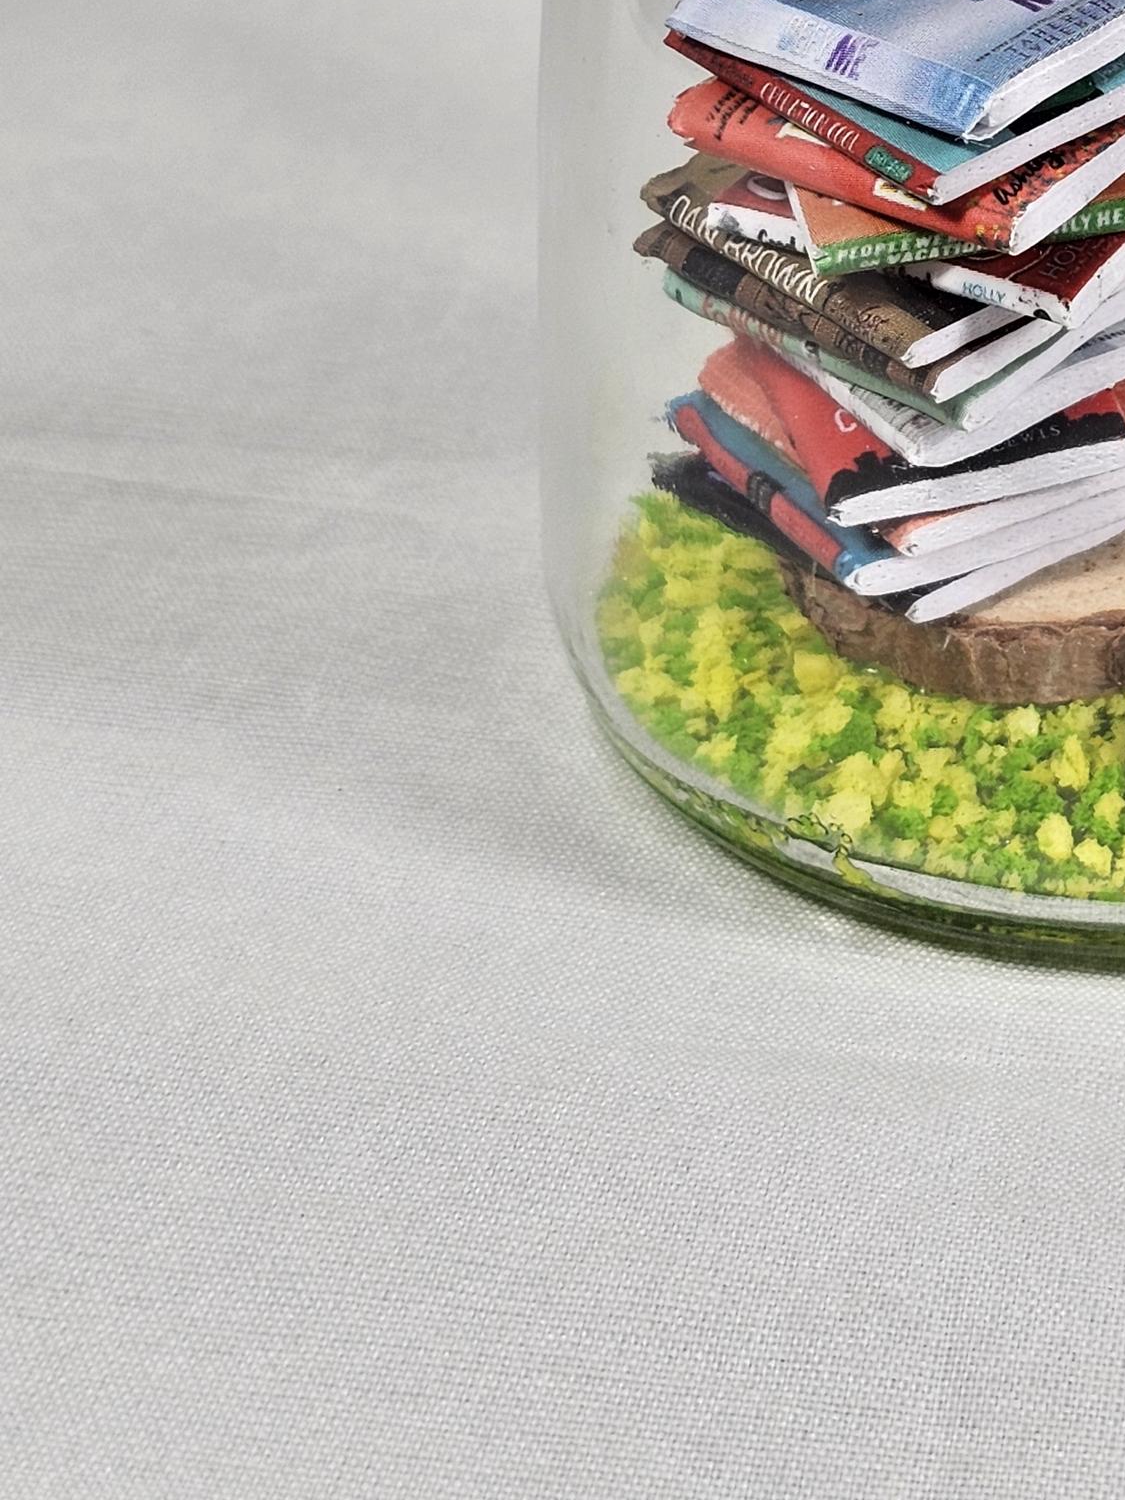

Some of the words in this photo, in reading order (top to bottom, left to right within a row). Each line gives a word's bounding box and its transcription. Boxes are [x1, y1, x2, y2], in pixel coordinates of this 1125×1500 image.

[838, 234, 912, 264] PEOPLE
[886, 240, 986, 264] VACATIO
[722, 237, 828, 305] BROWN
[962, 280, 1006, 304] HOLLY
